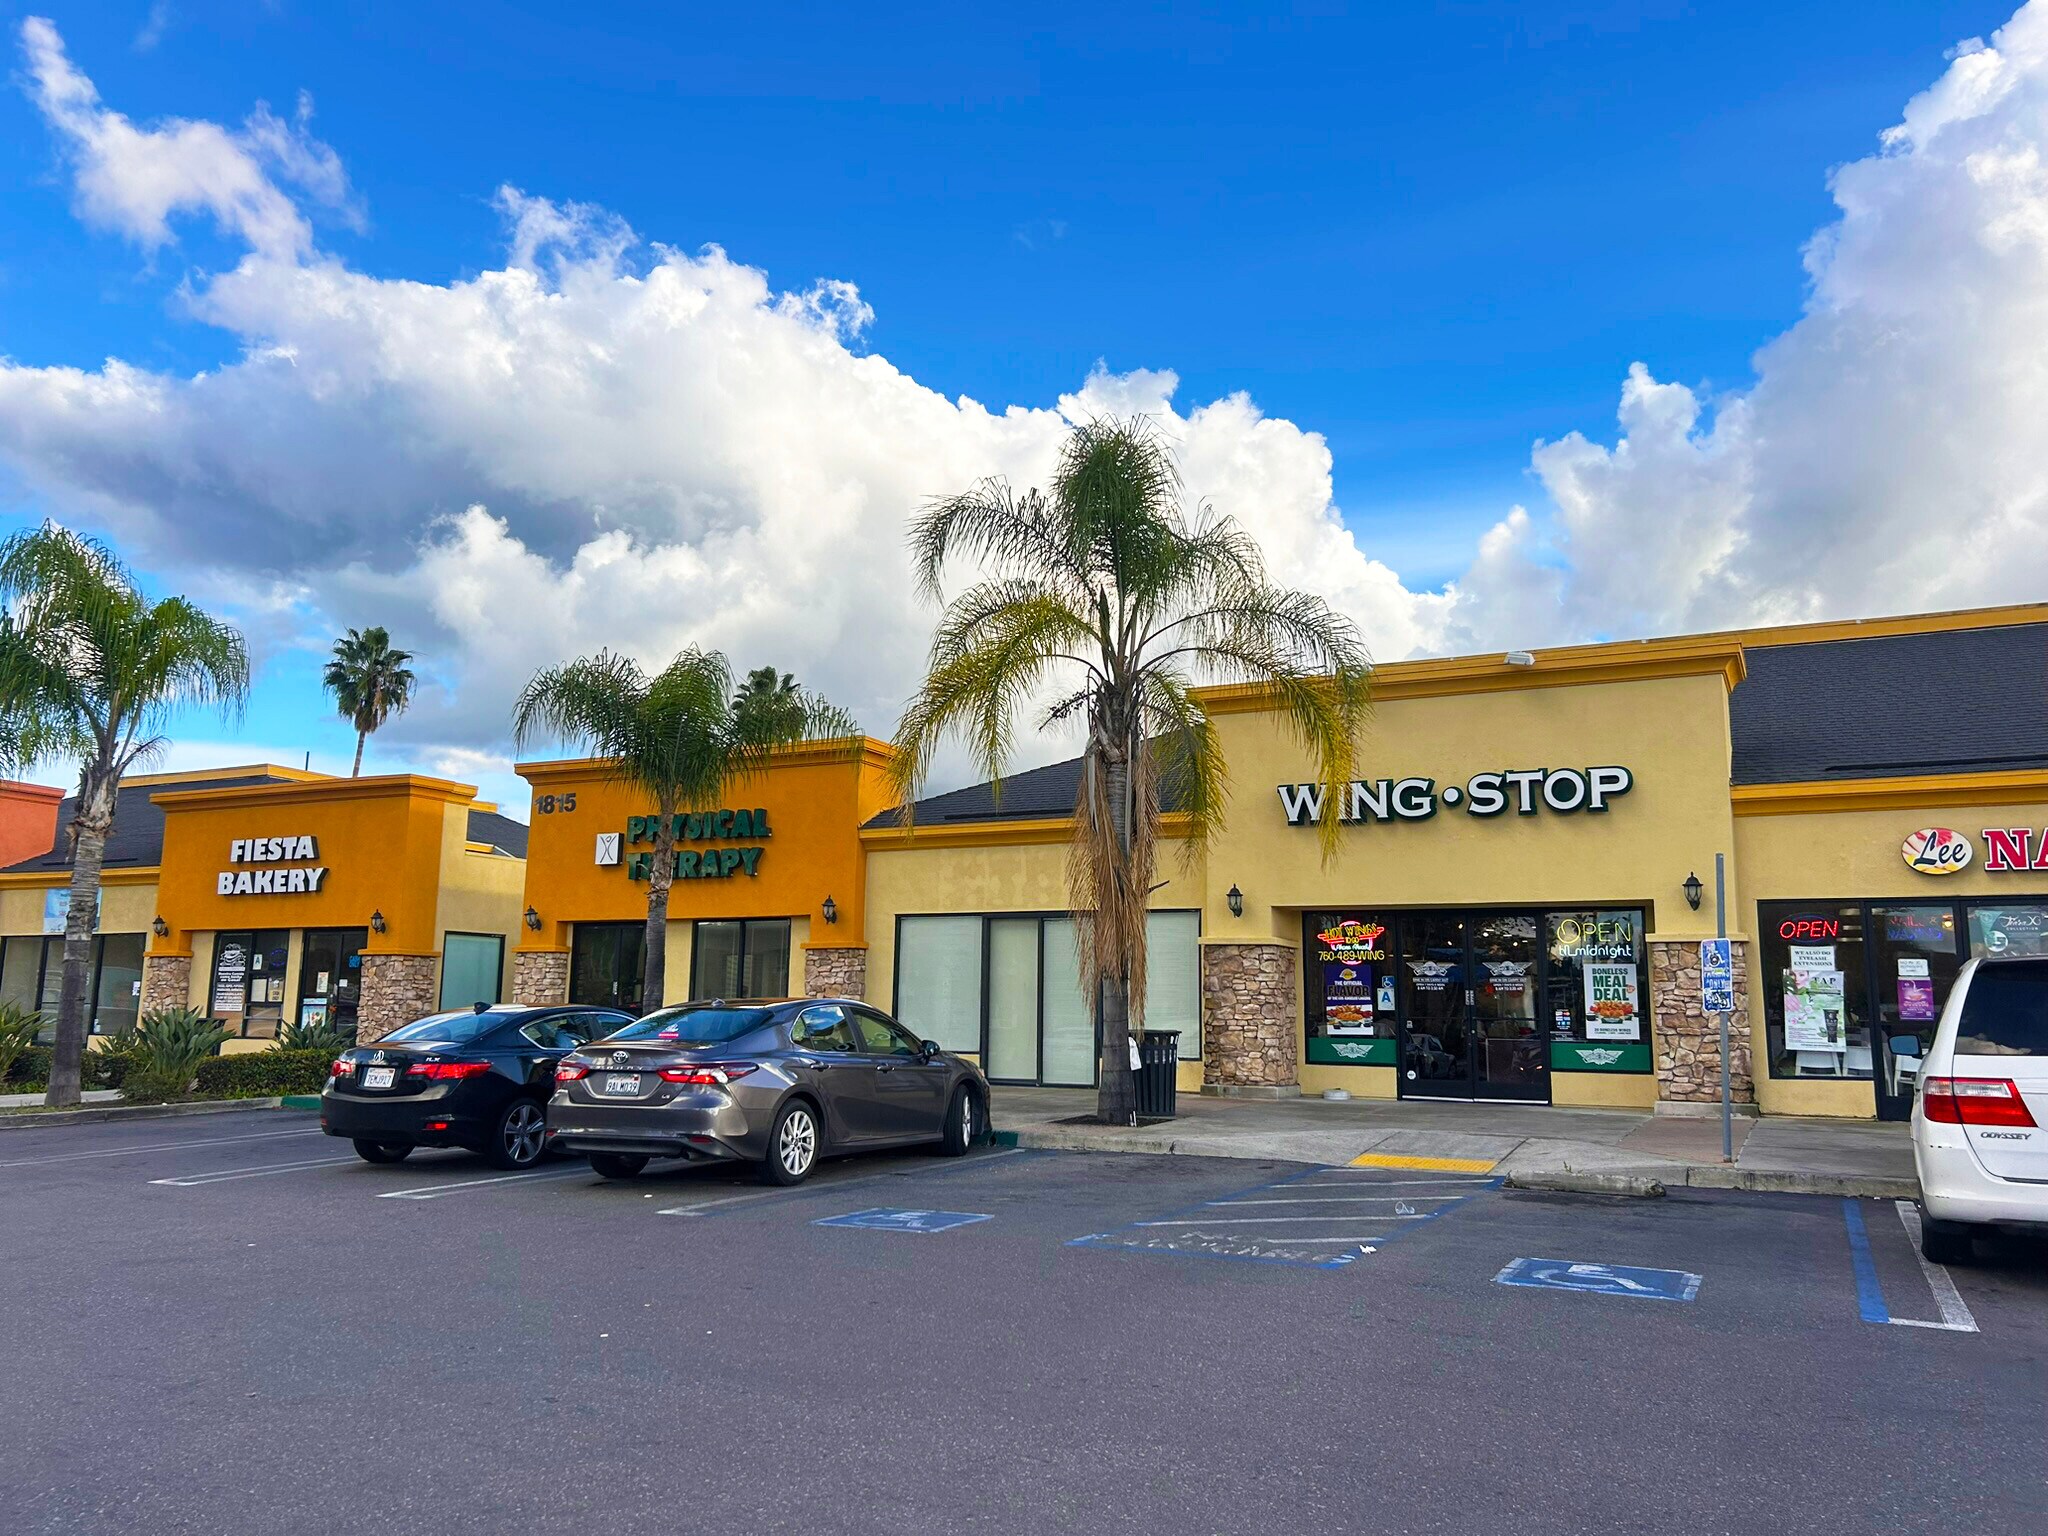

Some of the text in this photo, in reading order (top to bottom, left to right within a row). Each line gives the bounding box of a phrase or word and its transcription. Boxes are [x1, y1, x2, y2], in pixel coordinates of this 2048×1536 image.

[1467, 765, 1633, 818] STOP
[535, 792, 577, 815] 1815
[626, 808, 772, 843] PHYSICAL
[230, 835, 319, 863] FIESTA
[1912, 830, 1967, 867] Lee
[217, 866, 328, 896] BAKERY
[1557, 919, 1632, 944] OPEN
[1780, 920, 1839, 939] OPEN
[1592, 967, 1629, 976] BONELESS
[1593, 975, 1628, 988] MEAL
[1328, 985, 1370, 997] FLAVOR
[1381, 991, 1392, 1003] A
[1593, 987, 1630, 1001] DEAL
[1981, 1132, 2031, 1140] ODYSSEY
